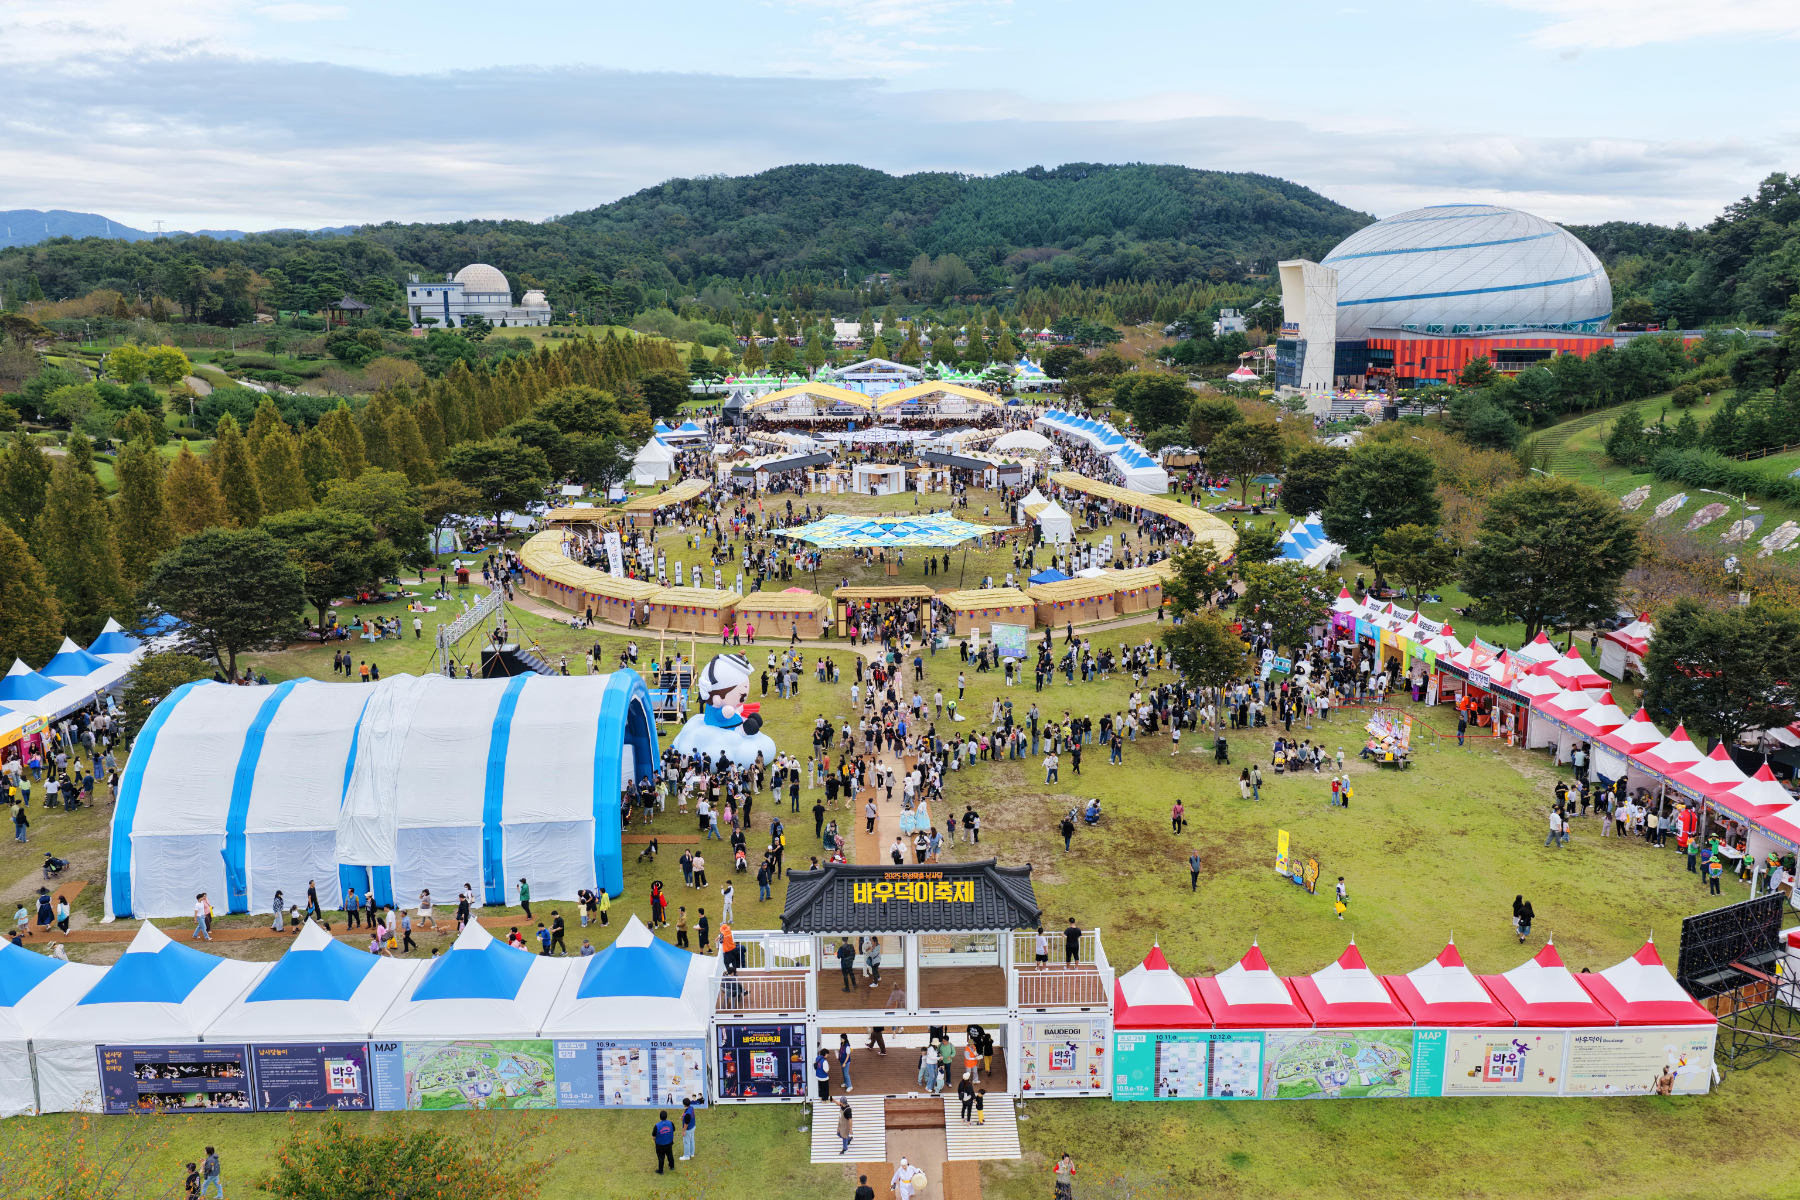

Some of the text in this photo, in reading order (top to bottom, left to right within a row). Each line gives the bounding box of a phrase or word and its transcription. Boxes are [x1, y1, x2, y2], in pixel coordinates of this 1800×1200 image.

[853, 881, 974, 904] 바우덕이축제
[1418, 1031, 1442, 1040] MAP
[375, 1043, 397, 1052] MAP
[1054, 1050, 1071, 1058] 바우
[755, 1056, 773, 1065] 바우
[1054, 1058, 1071, 1066] 덕이
[1493, 1053, 1518, 1065] 바우
[332, 1066, 355, 1077] 바우
[756, 1064, 773, 1072] 덕이
[1491, 1065, 1517, 1077] 덕이
[333, 1077, 356, 1088] 덕이
